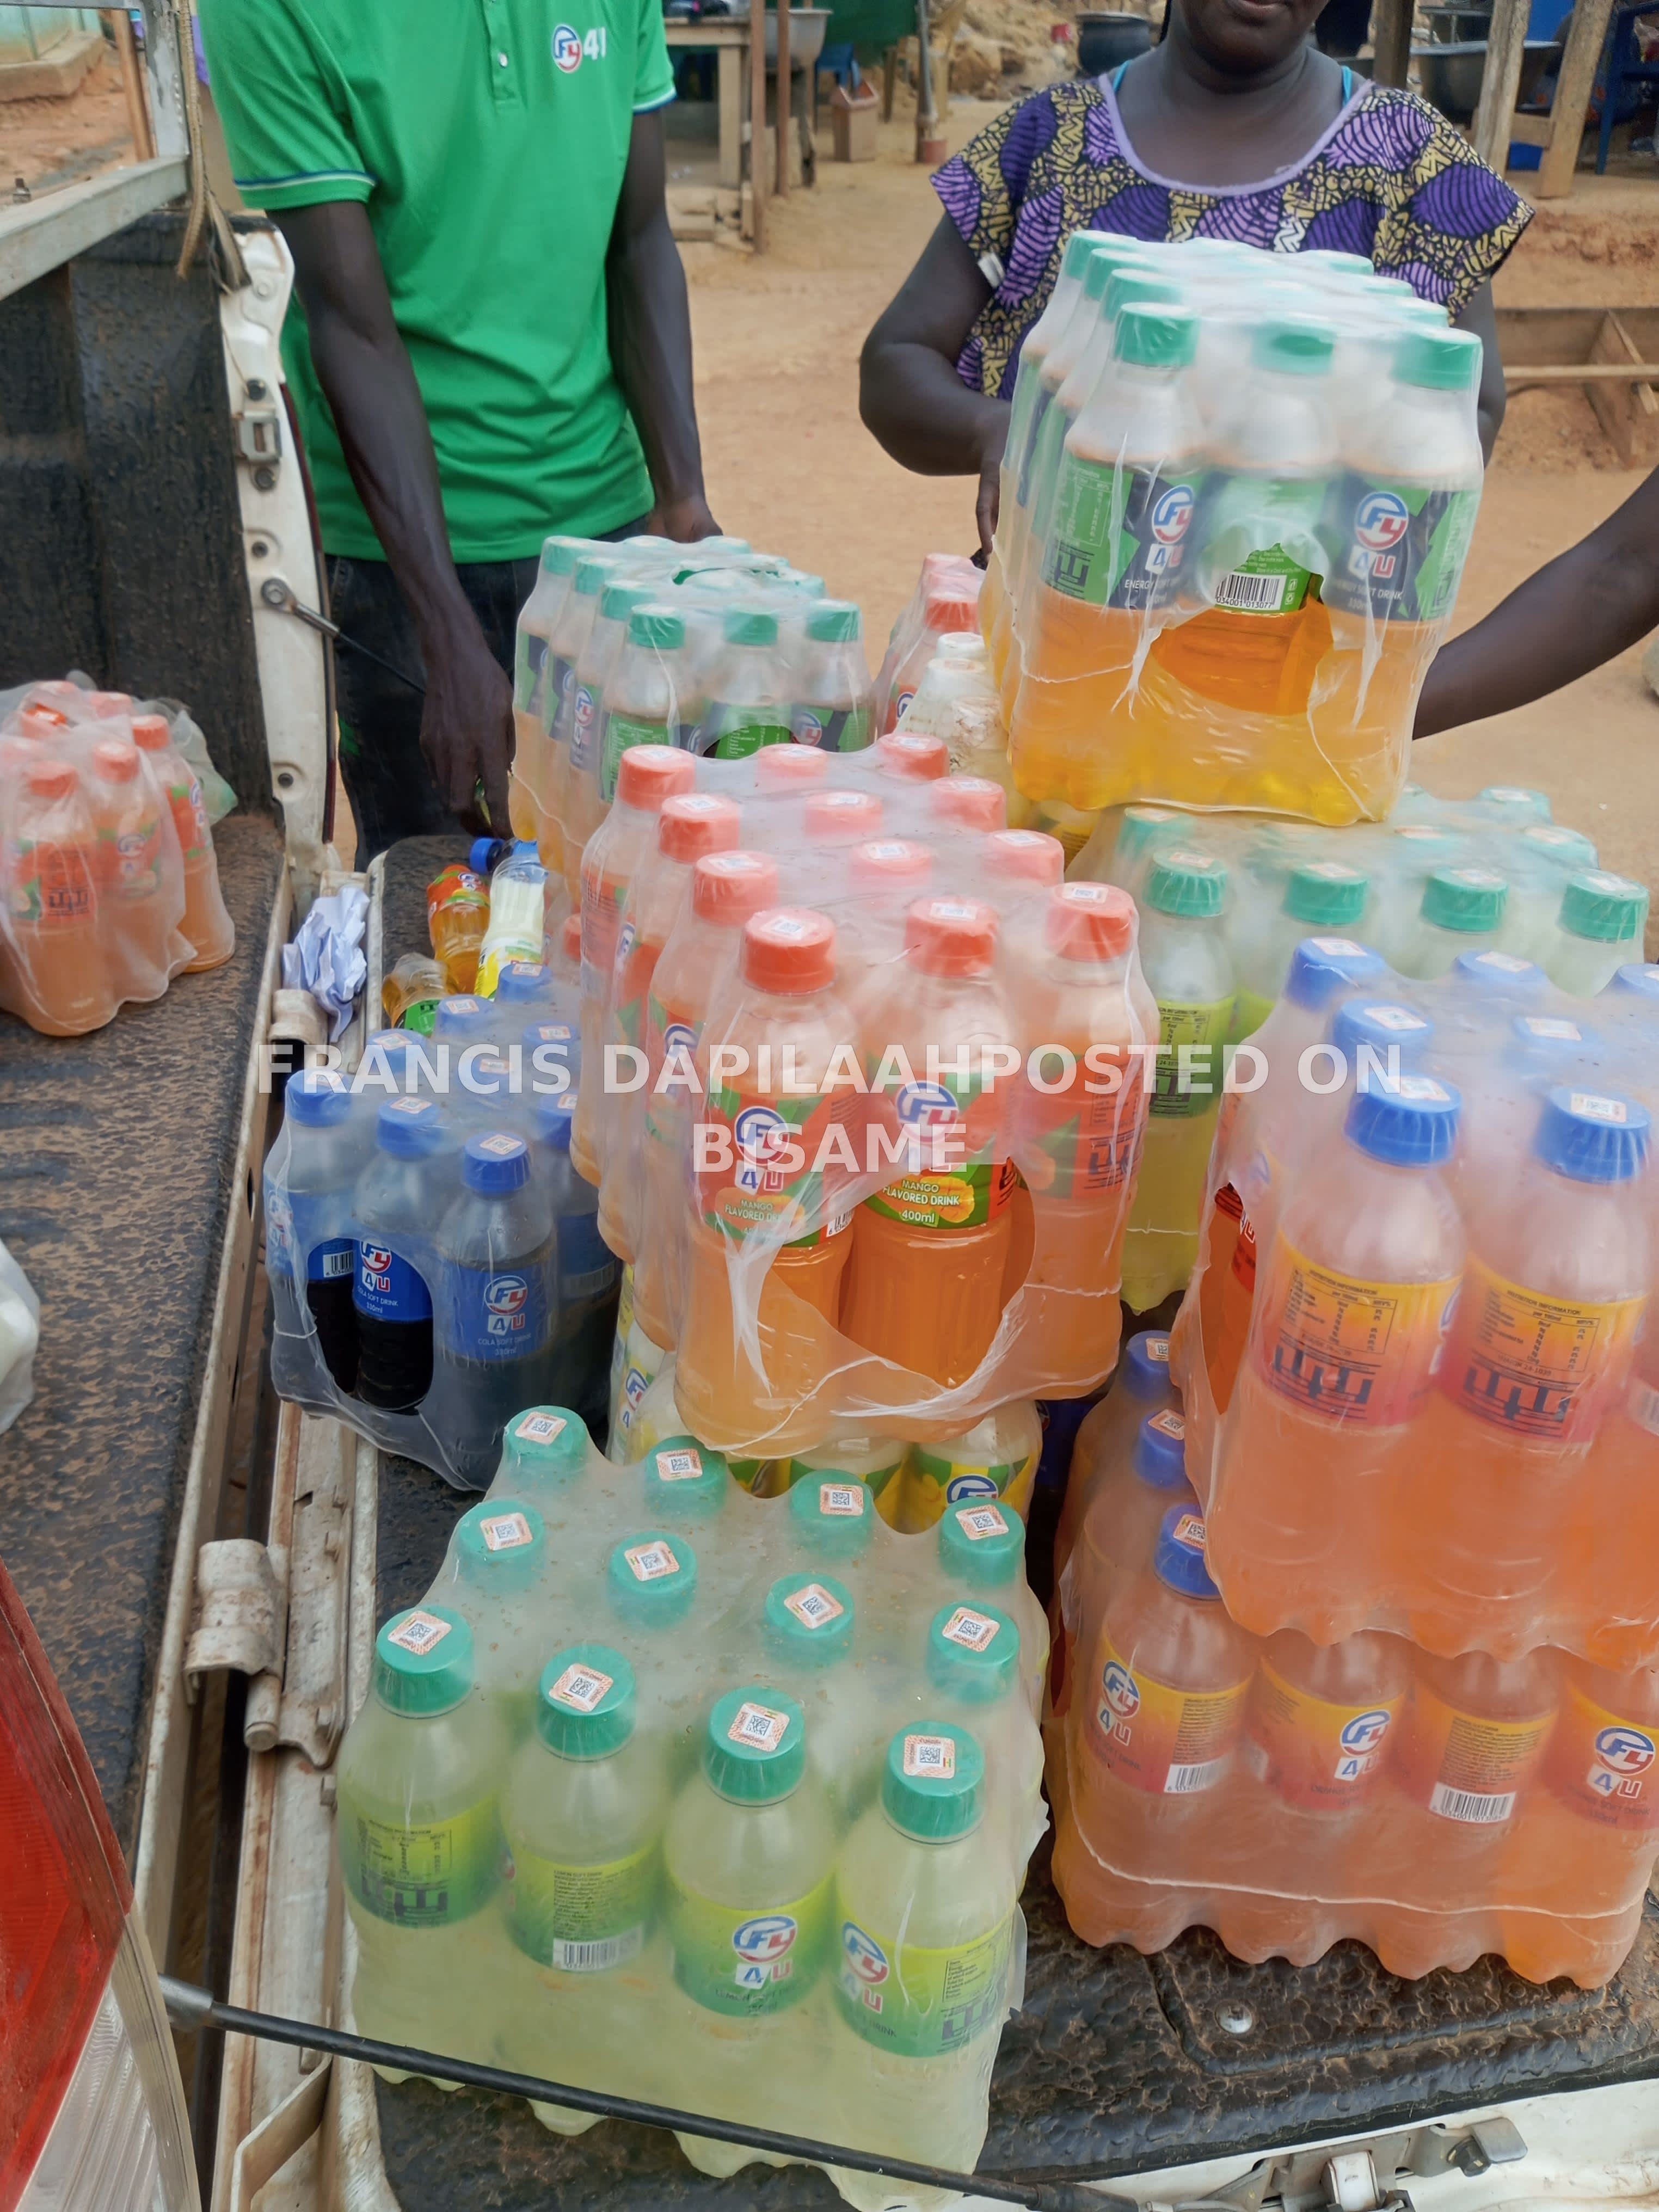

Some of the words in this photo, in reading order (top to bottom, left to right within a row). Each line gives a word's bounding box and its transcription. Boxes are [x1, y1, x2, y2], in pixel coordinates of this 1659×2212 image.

[902, 1179, 939, 1193] MANGO
[882, 1185, 929, 1205] FLAVORED
[930, 1195, 960, 1206] DRINK
[740, 1199, 773, 1211] MANGO
[724, 1205, 765, 1221] FLAVORED
[901, 1210, 935, 1224] 400ml
[367, 1293, 379, 1302] SOFT
